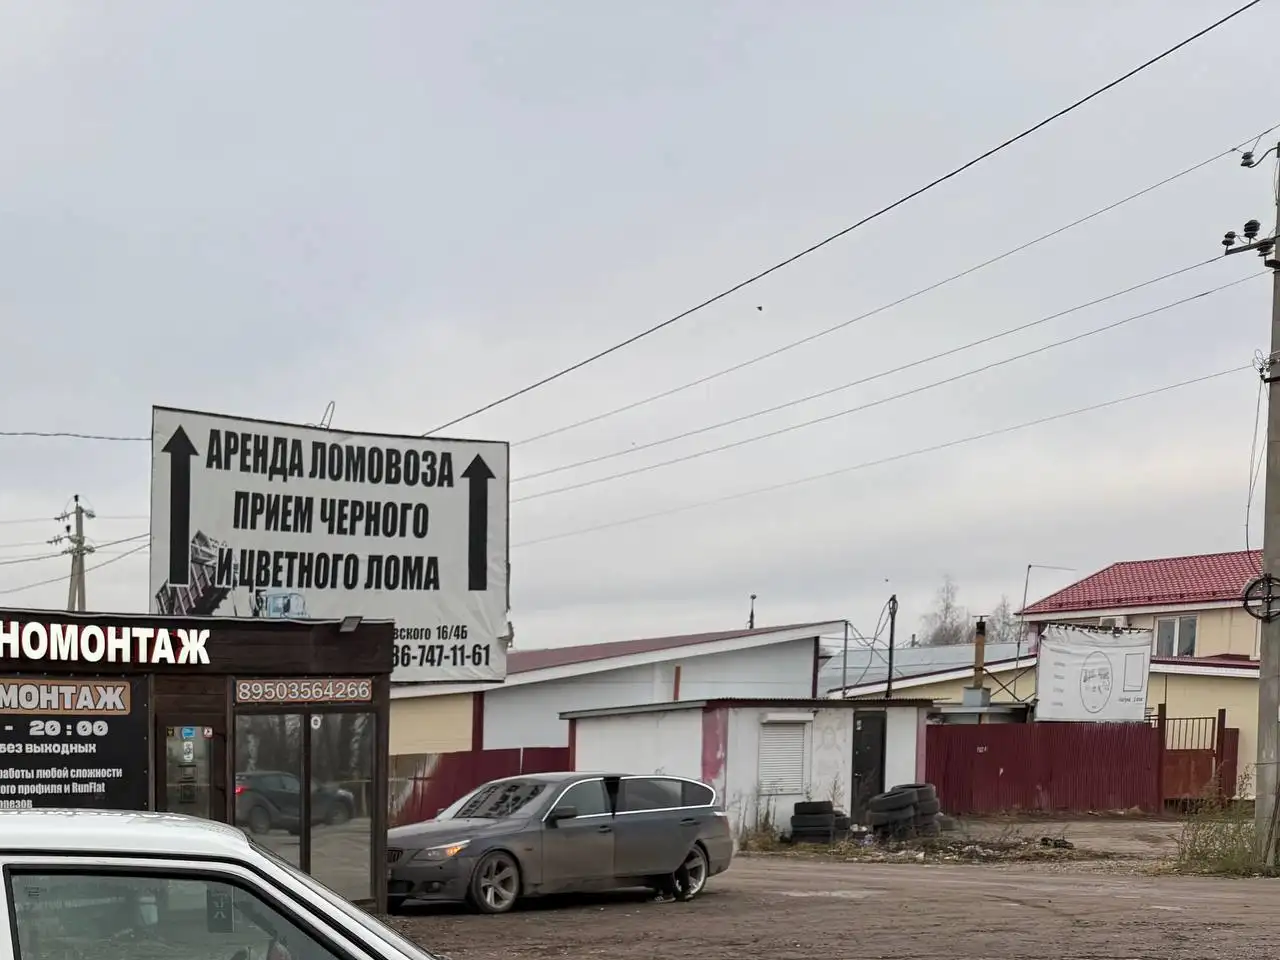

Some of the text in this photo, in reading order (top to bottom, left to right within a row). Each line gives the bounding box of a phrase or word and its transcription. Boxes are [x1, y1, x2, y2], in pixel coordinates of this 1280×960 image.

[205, 428, 455, 488] АРЕНДА ЛОМОВОЗА
[233, 491, 429, 538] ПРИЕМ ЧЕРНОГО
[238, 551, 359, 594] ЦВЕТНОГО
[364, 555, 440, 591] ЛОМА
[436, 625, 467, 640] 16/4Б
[238, 681, 370, 699] 89503564266
[29, 720, 109, 736] 20:00
[36, 767, 68, 779] любой
[70, 768, 123, 779] сложности
[18, 782, 62, 795] профиля
[64, 783, 70, 793] и
[72, 782, 105, 793] RunFlat
